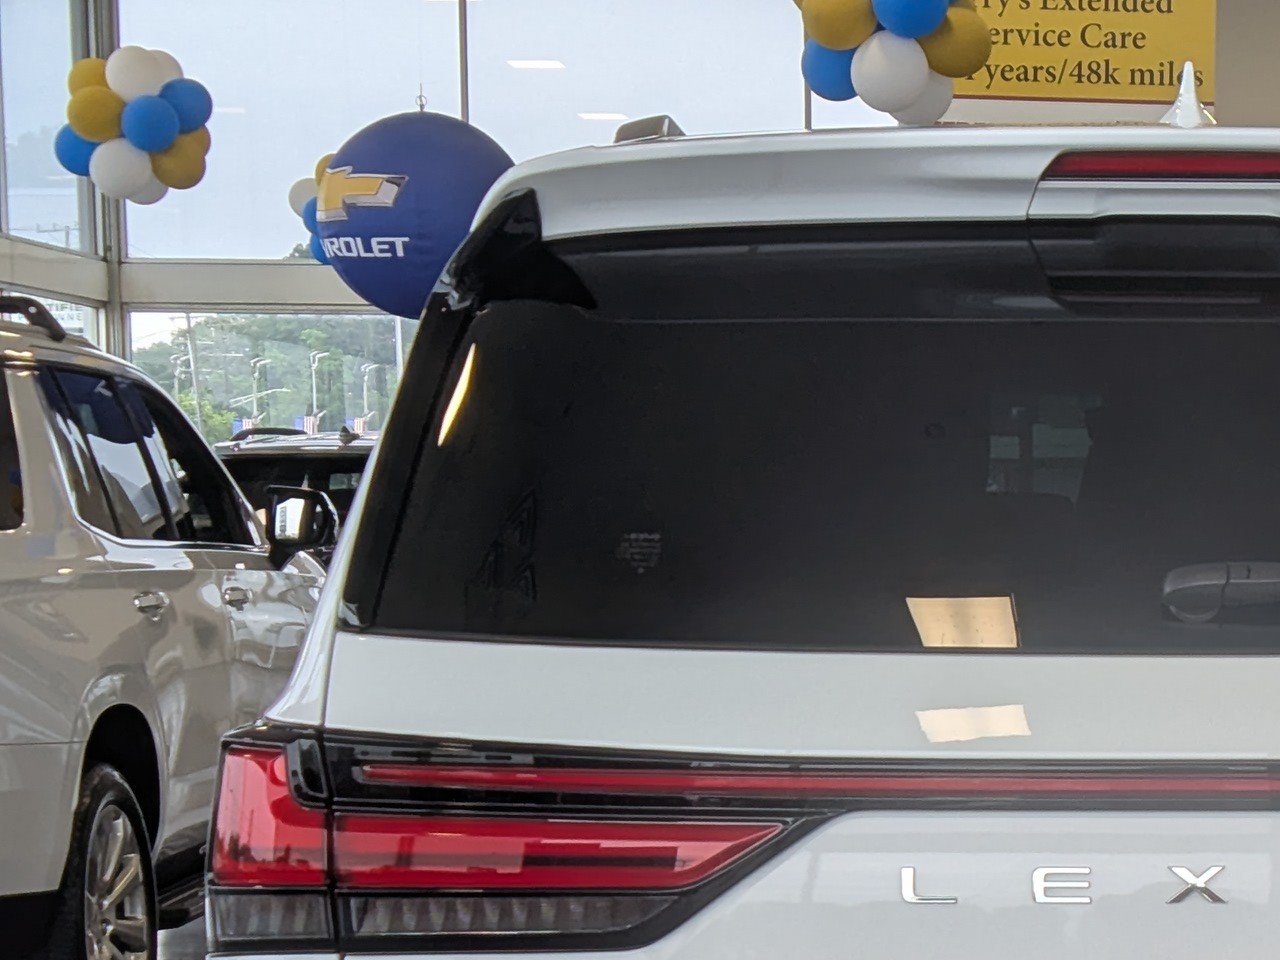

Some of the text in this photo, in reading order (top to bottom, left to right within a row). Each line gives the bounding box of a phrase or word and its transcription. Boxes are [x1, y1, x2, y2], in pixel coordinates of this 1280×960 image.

[989, 22, 1147, 49] ervice Care
[984, 58, 1120, 90] years/48k
